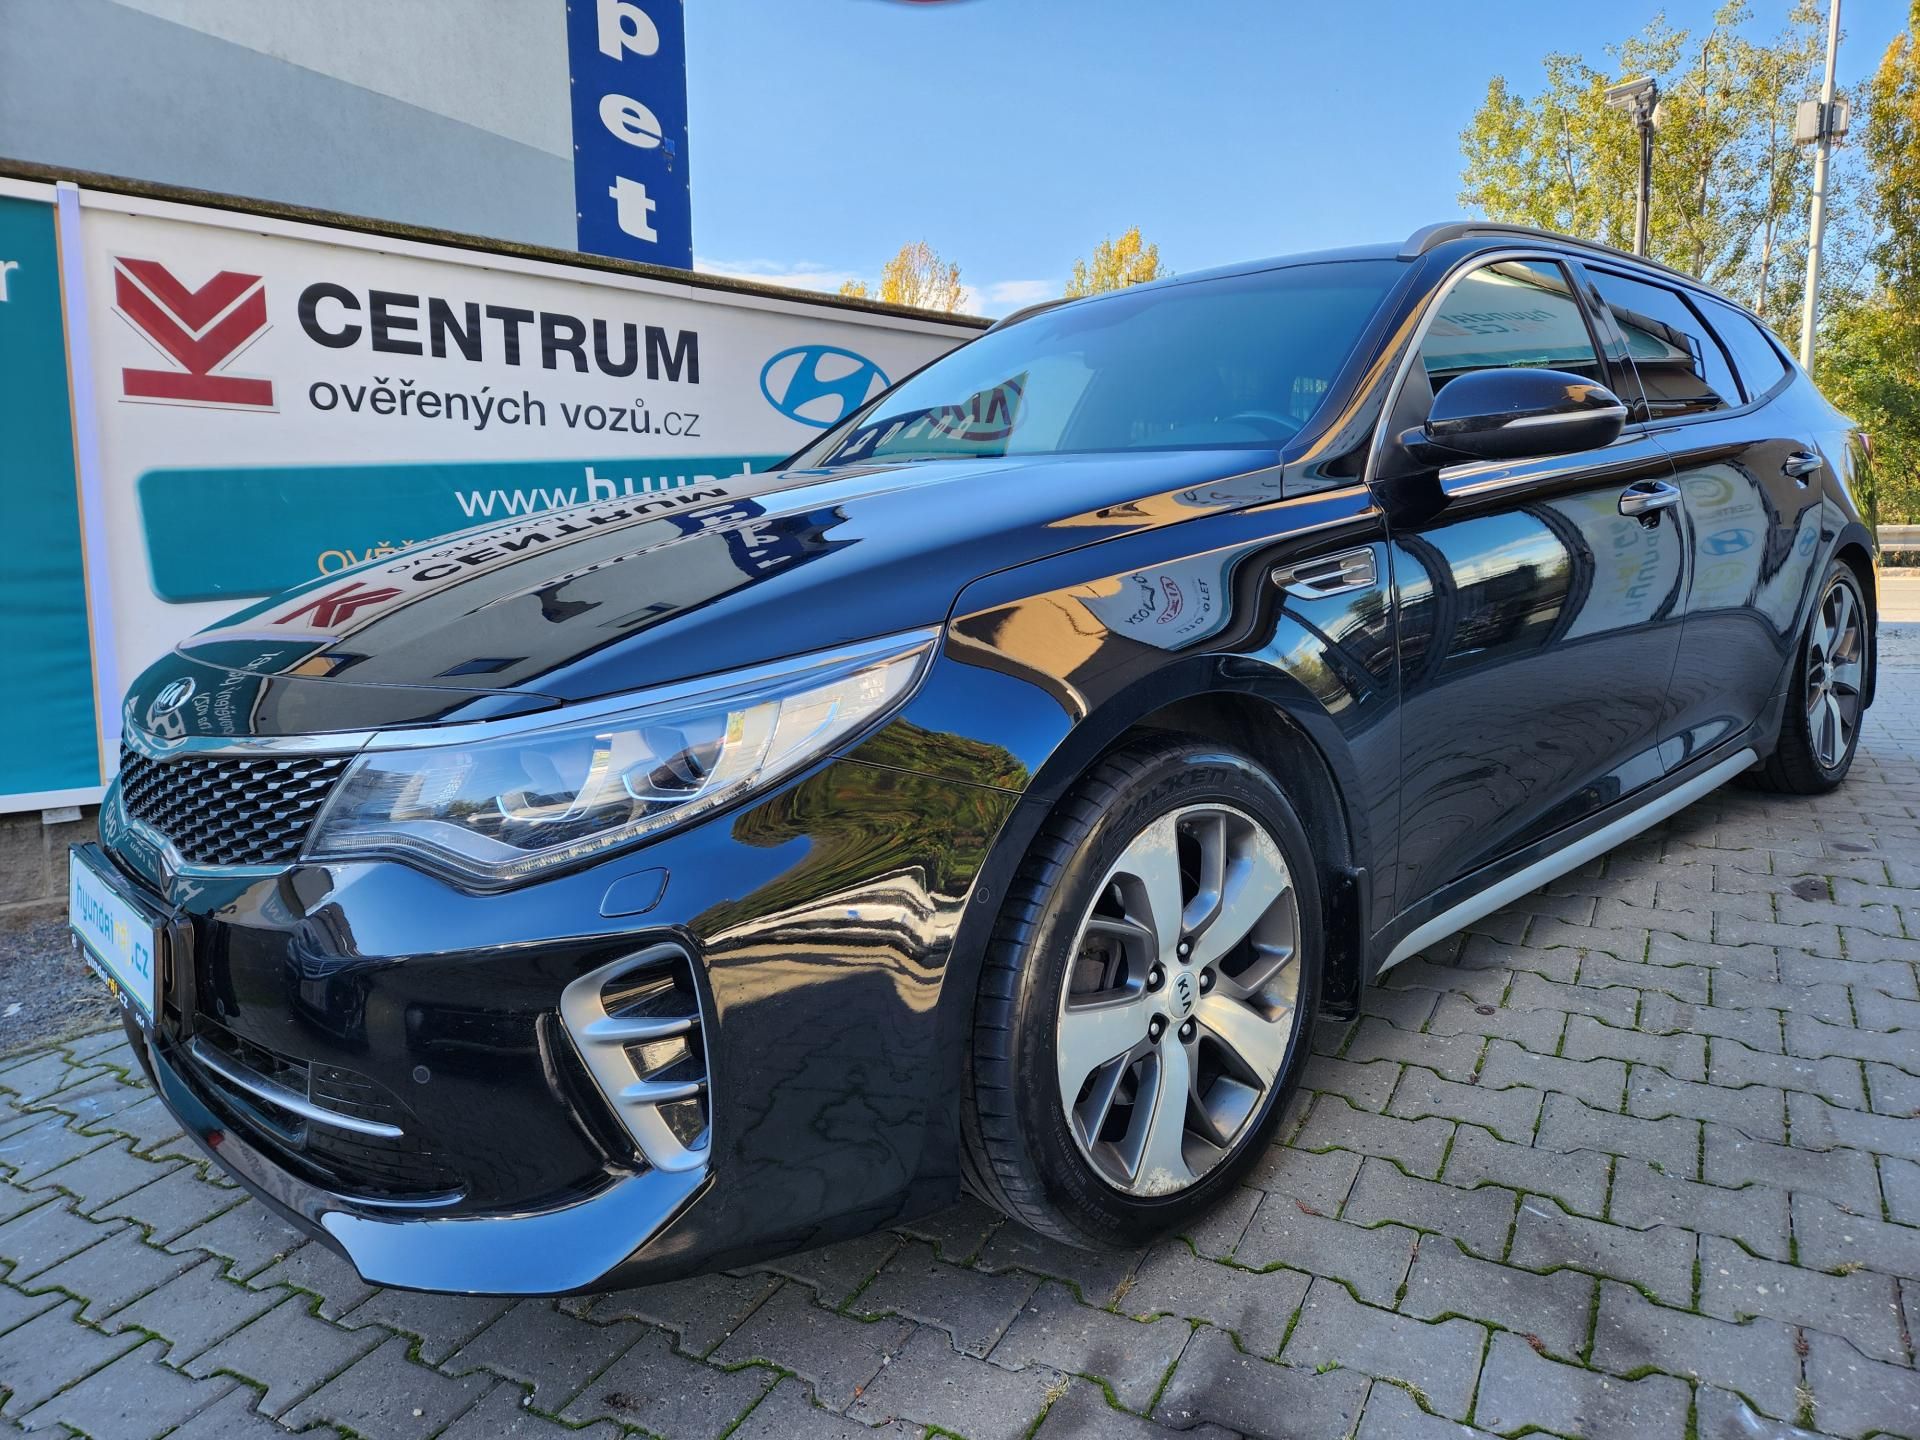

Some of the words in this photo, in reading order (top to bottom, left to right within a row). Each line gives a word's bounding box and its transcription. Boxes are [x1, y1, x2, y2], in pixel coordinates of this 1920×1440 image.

[298, 282, 700, 385] CENTRUM
[308, 376, 546, 431] ověřených
[560, 397, 701, 437] vozů.cz
[1177, 978, 1192, 1014] KIA
